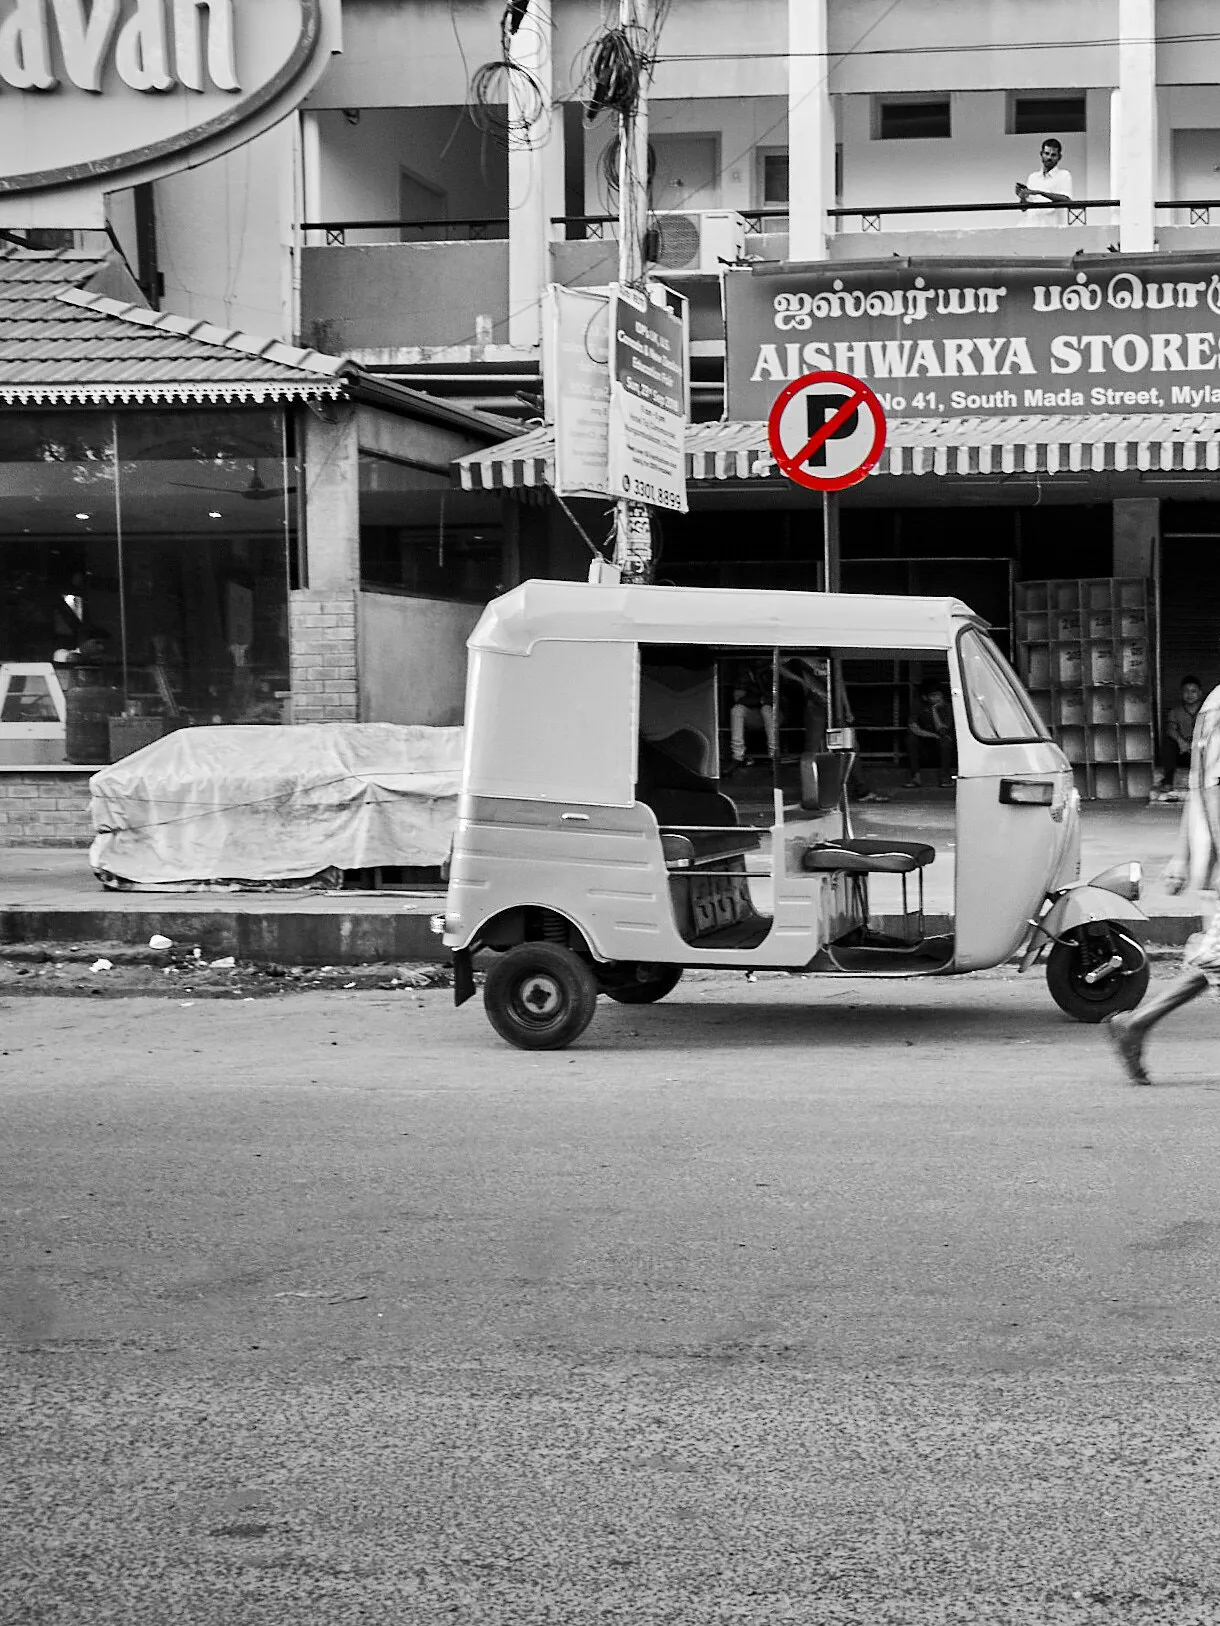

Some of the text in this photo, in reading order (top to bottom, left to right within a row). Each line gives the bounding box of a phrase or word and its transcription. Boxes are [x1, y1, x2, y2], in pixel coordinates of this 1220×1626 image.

[773, 276, 1008, 330] ஐஸ்வர்யா
[750, 337, 1038, 381] AISHWARYA
[911, 391, 945, 412] 41,
[951, 388, 1018, 409] South
[1024, 388, 1084, 407] Mada
[1090, 387, 1164, 407] Street,
[806, 394, 859, 467] P
